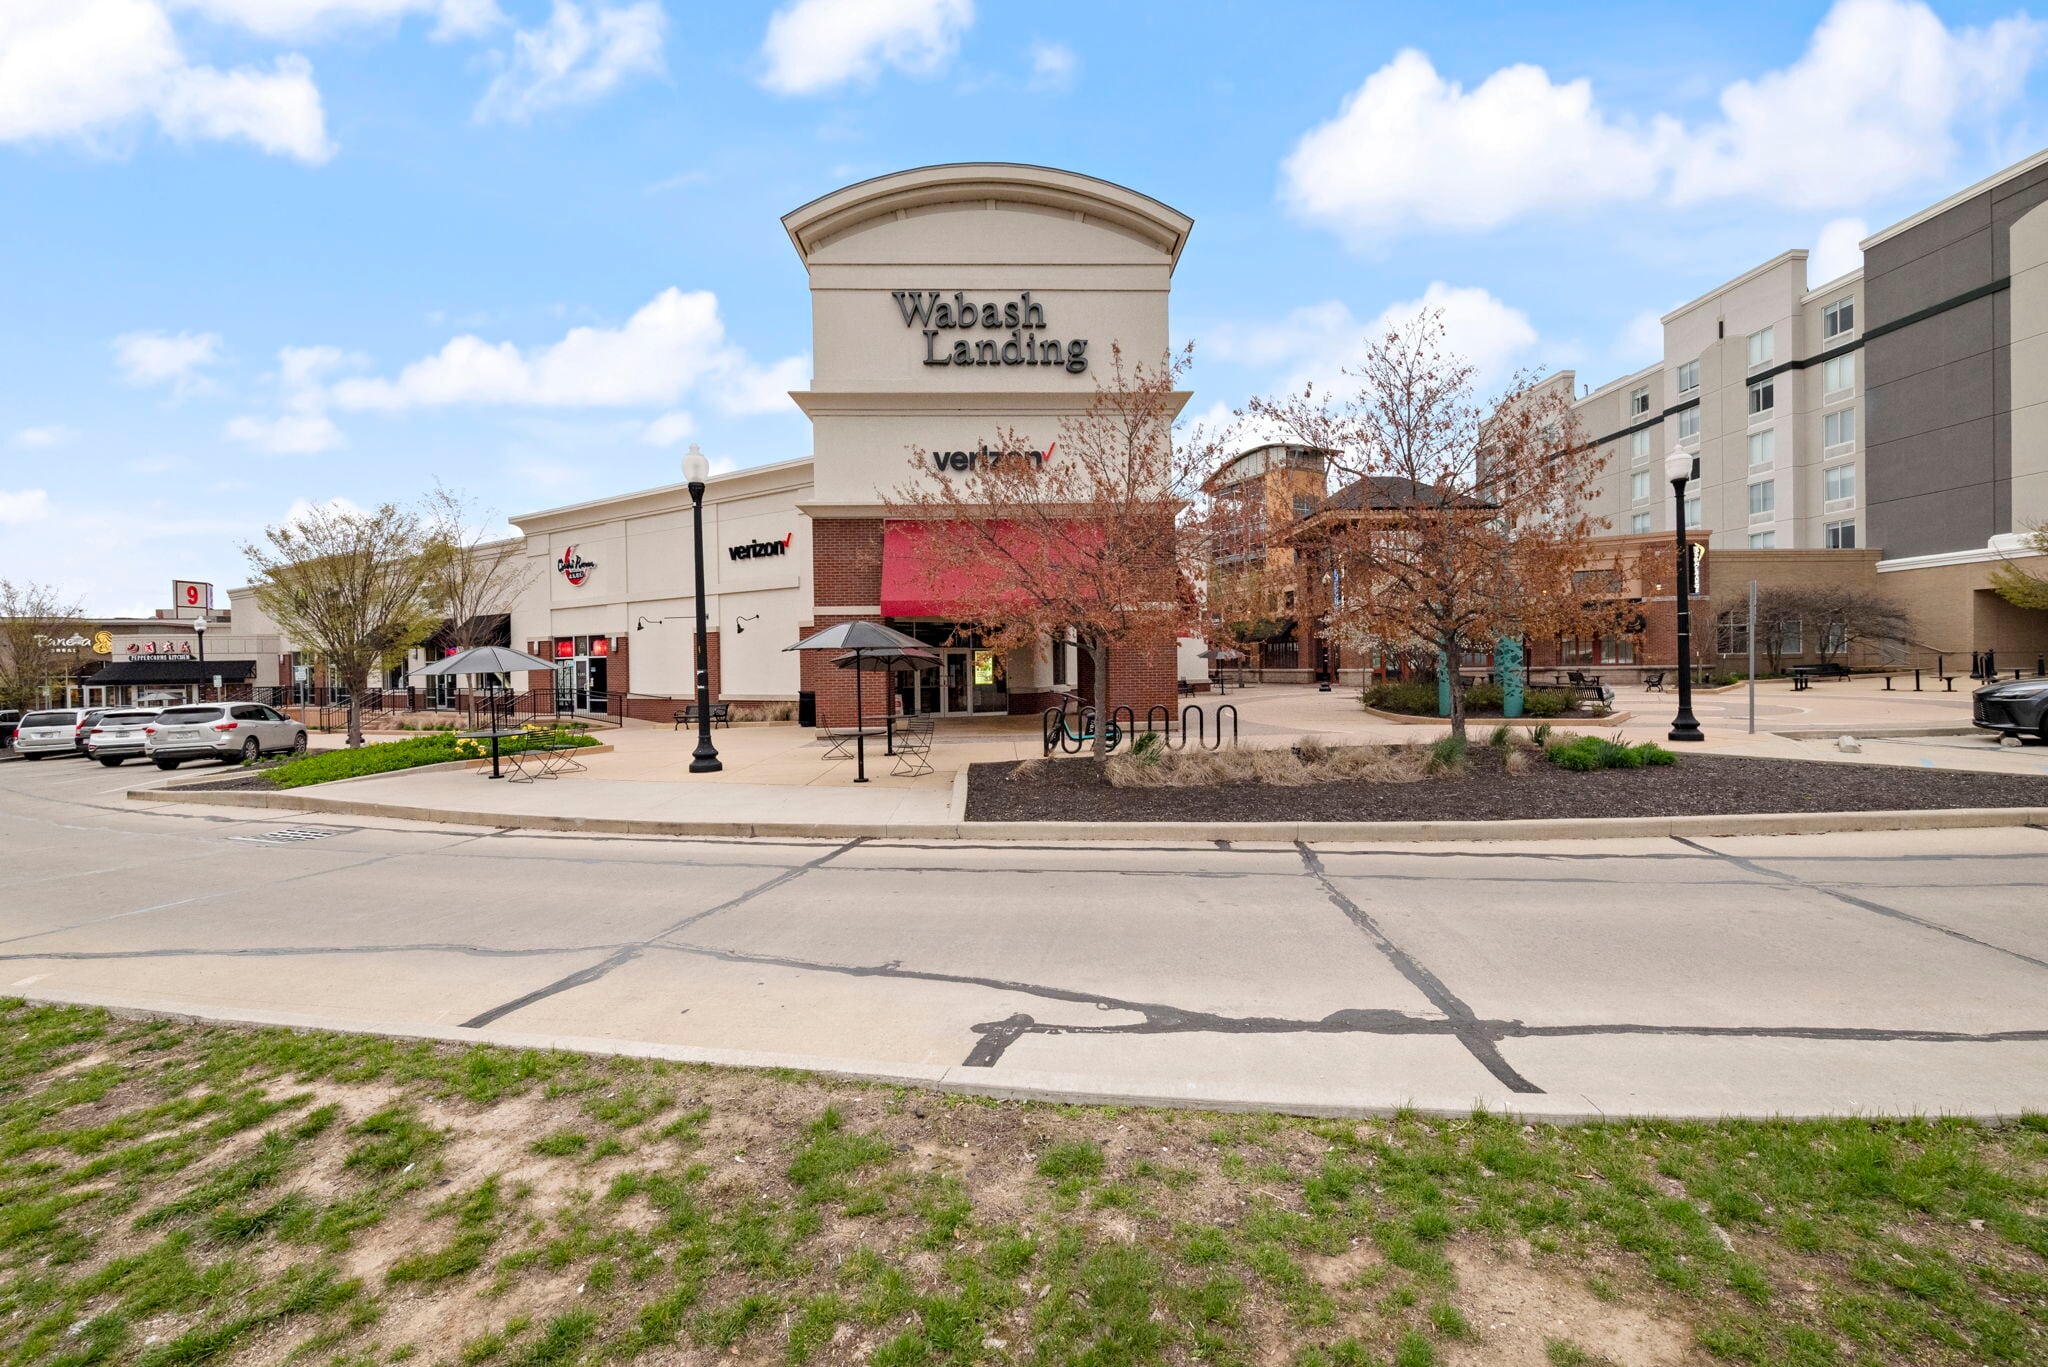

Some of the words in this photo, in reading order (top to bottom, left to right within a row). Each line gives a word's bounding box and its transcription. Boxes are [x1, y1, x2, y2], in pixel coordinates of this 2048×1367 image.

[892, 291, 1046, 329] Wabash
[923, 329, 1088, 373] Landing
[729, 539, 785, 560] verizon
[187, 586, 199, 605] 9
[33, 633, 92, 648] Panea
